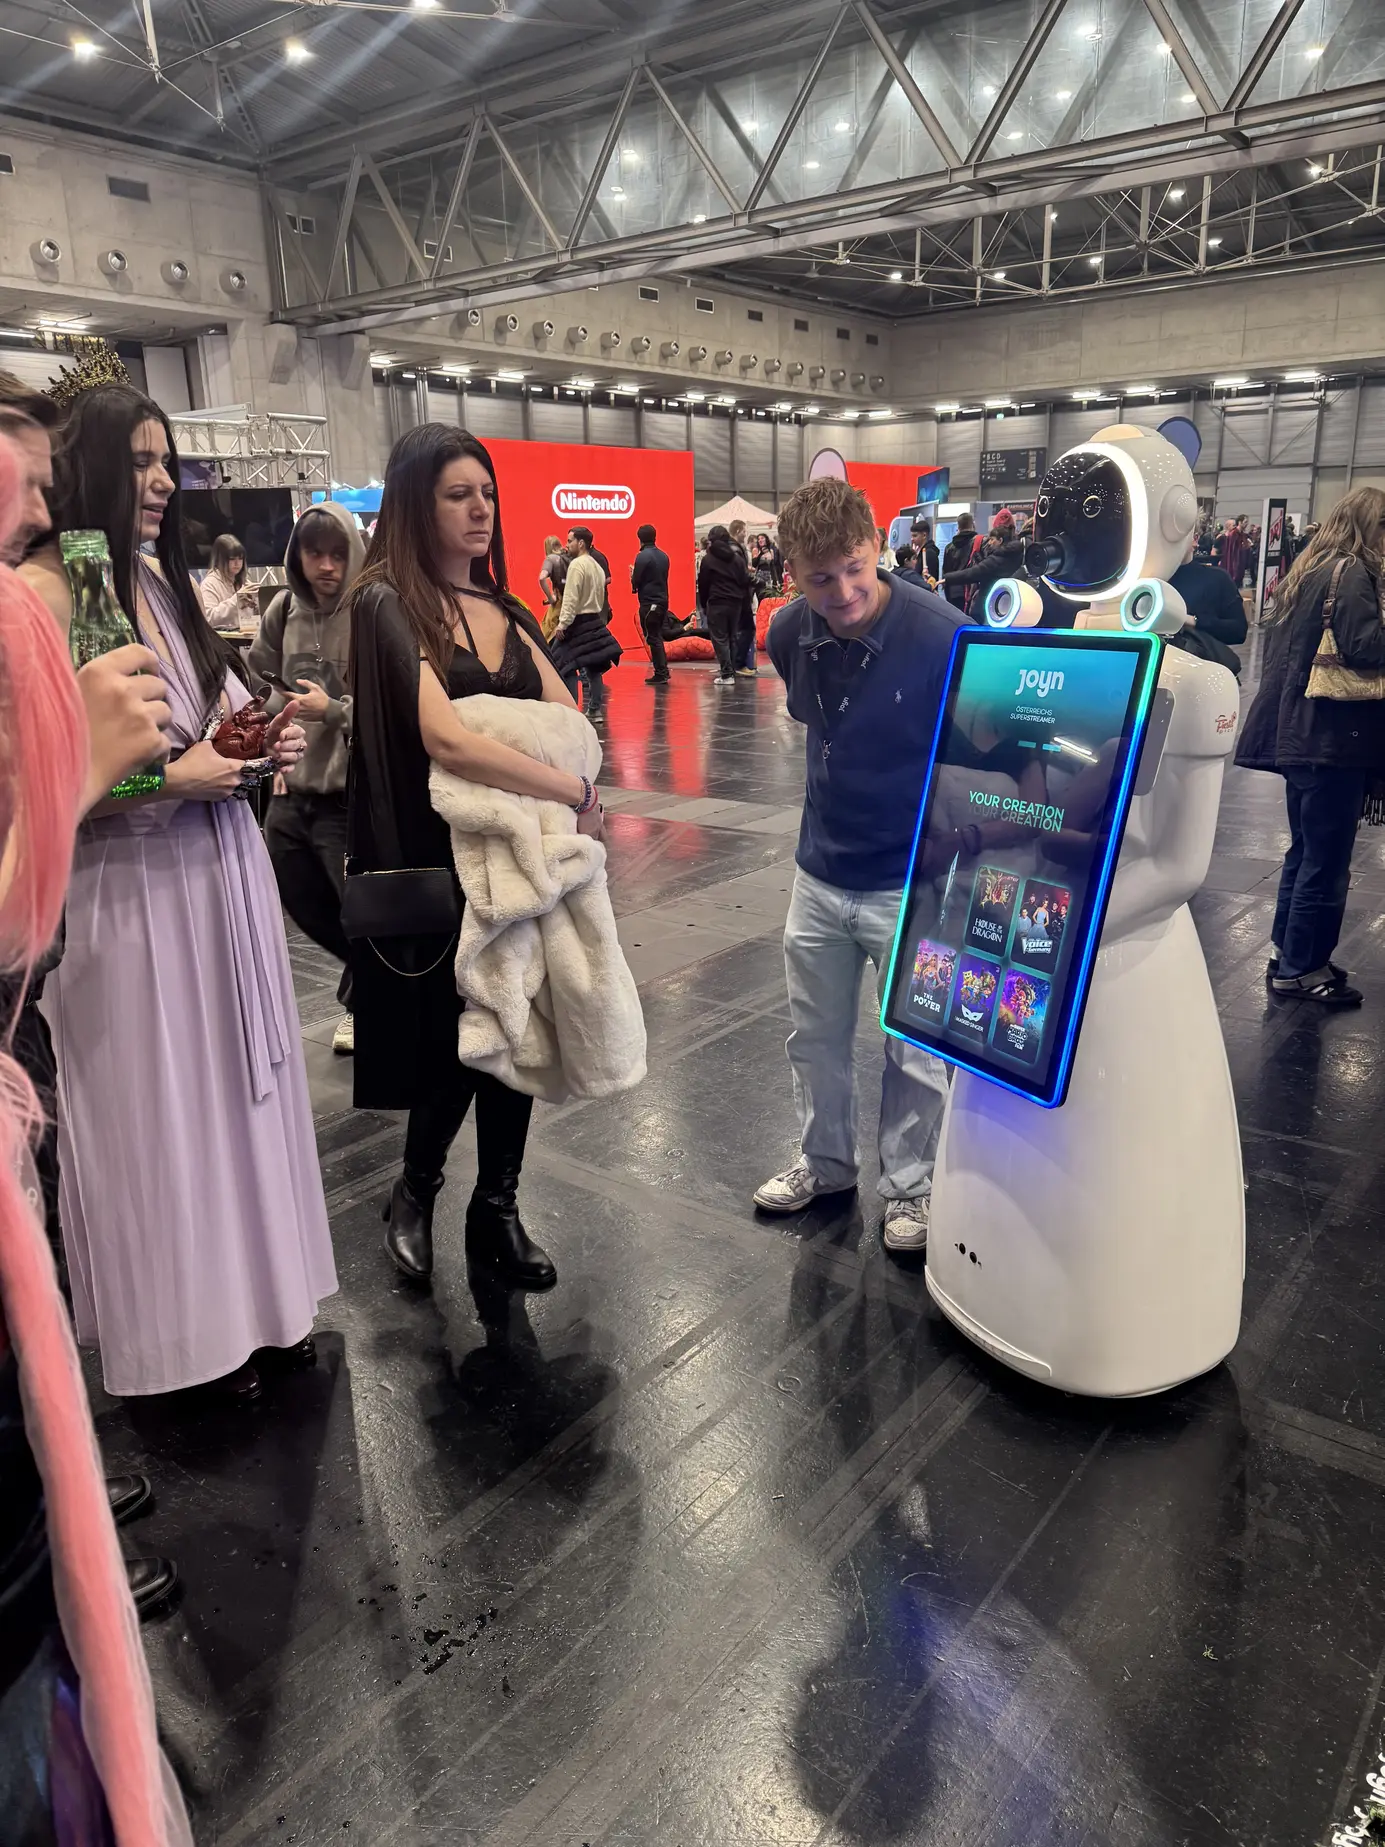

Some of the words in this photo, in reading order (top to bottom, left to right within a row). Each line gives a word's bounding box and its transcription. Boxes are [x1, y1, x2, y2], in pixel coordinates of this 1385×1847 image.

[560, 492, 629, 511] Nintendo
[1009, 712, 1056, 724] SUPERSTREAMER
[1015, 705, 1053, 716] ÖSTERREICHS
[968, 790, 1000, 808] YOUR
[1002, 797, 1065, 821] CREATION
[974, 917, 997, 932] HOUSE
[972, 926, 1003, 943] DRAGON
[913, 994, 941, 1013] POWER
[923, 992, 934, 1001] THE
